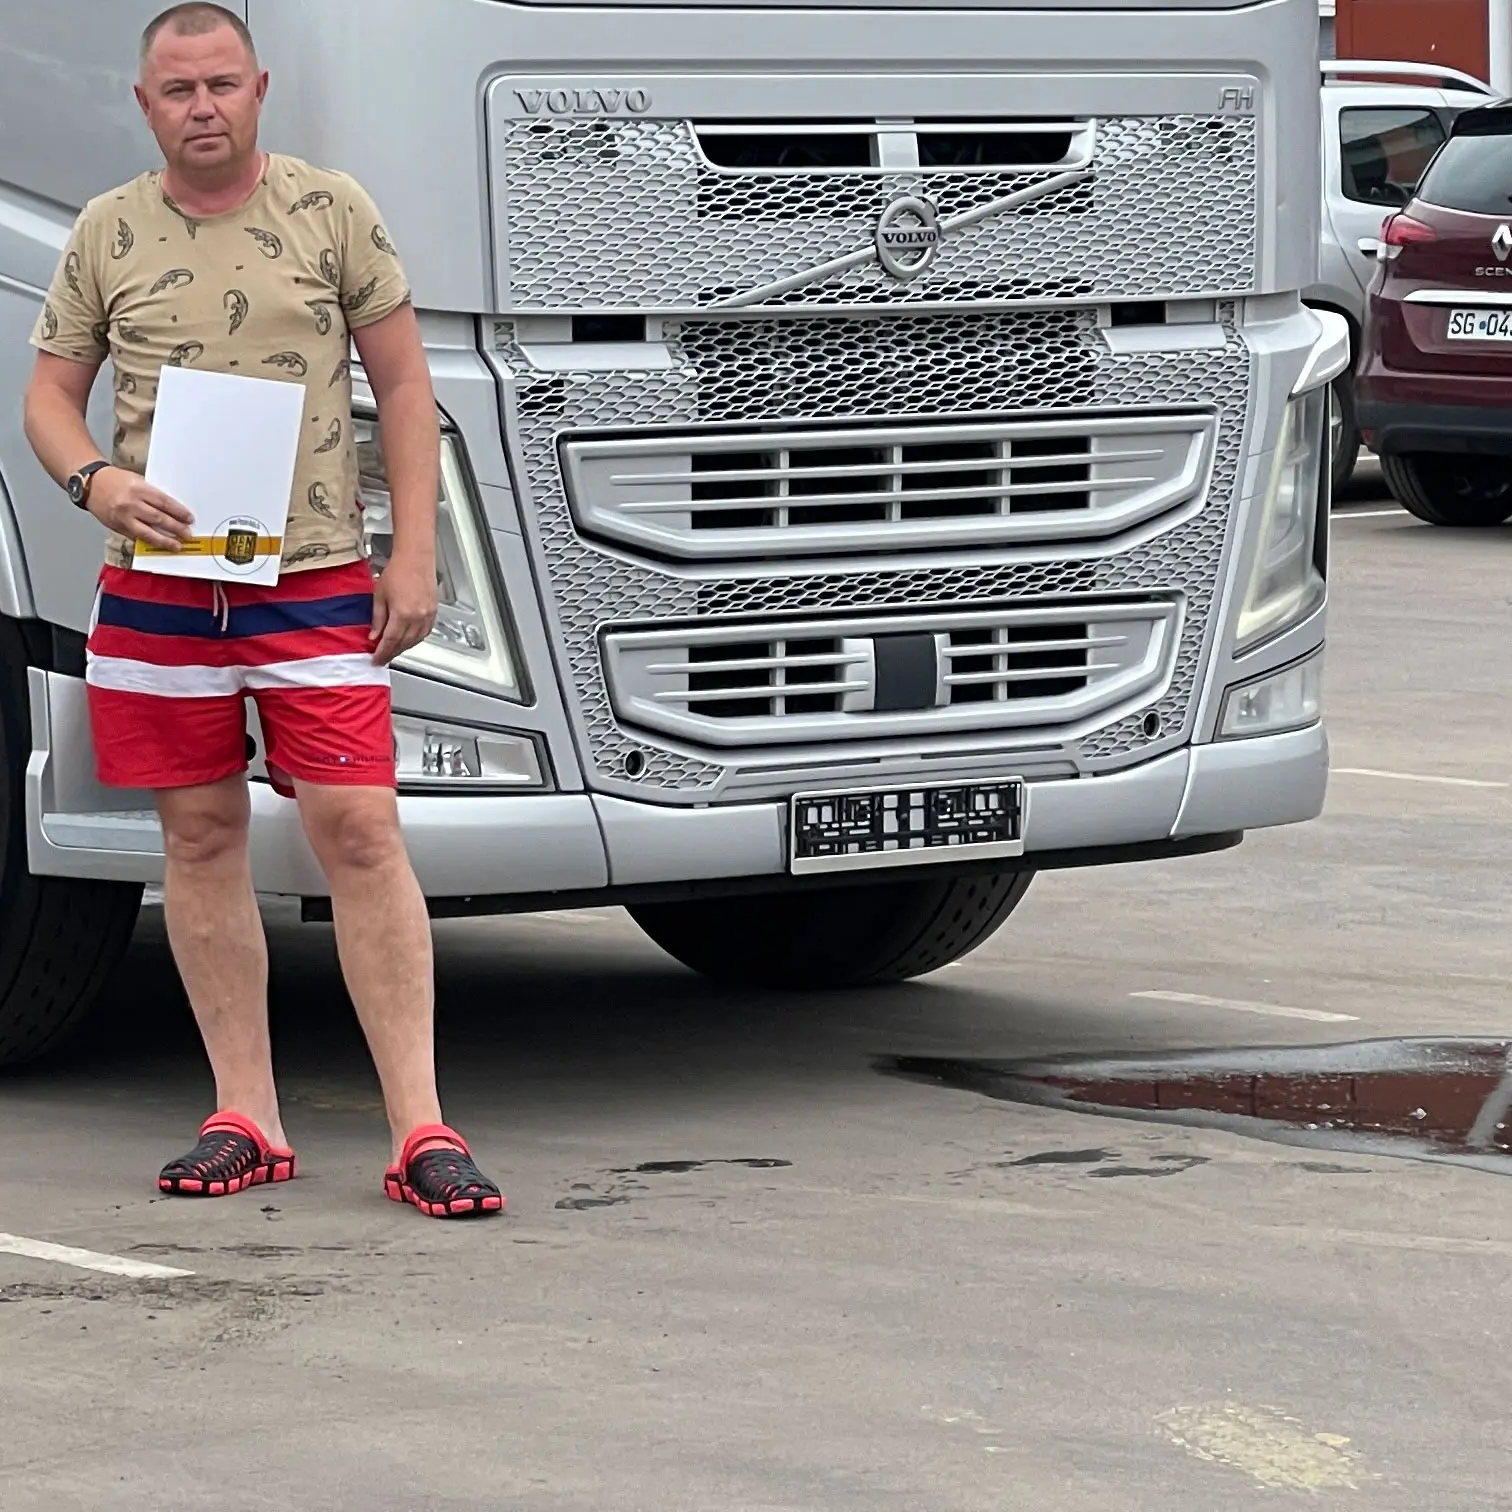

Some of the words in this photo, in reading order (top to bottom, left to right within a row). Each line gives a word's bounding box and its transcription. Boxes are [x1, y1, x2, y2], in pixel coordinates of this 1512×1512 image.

[512, 88, 653, 114] VOLVO
[1218, 87, 1254, 110] FH
[881, 231, 937, 244] VOLVO
[1451, 312, 1476, 335] SG
[1486, 313, 1512, 337] 04
